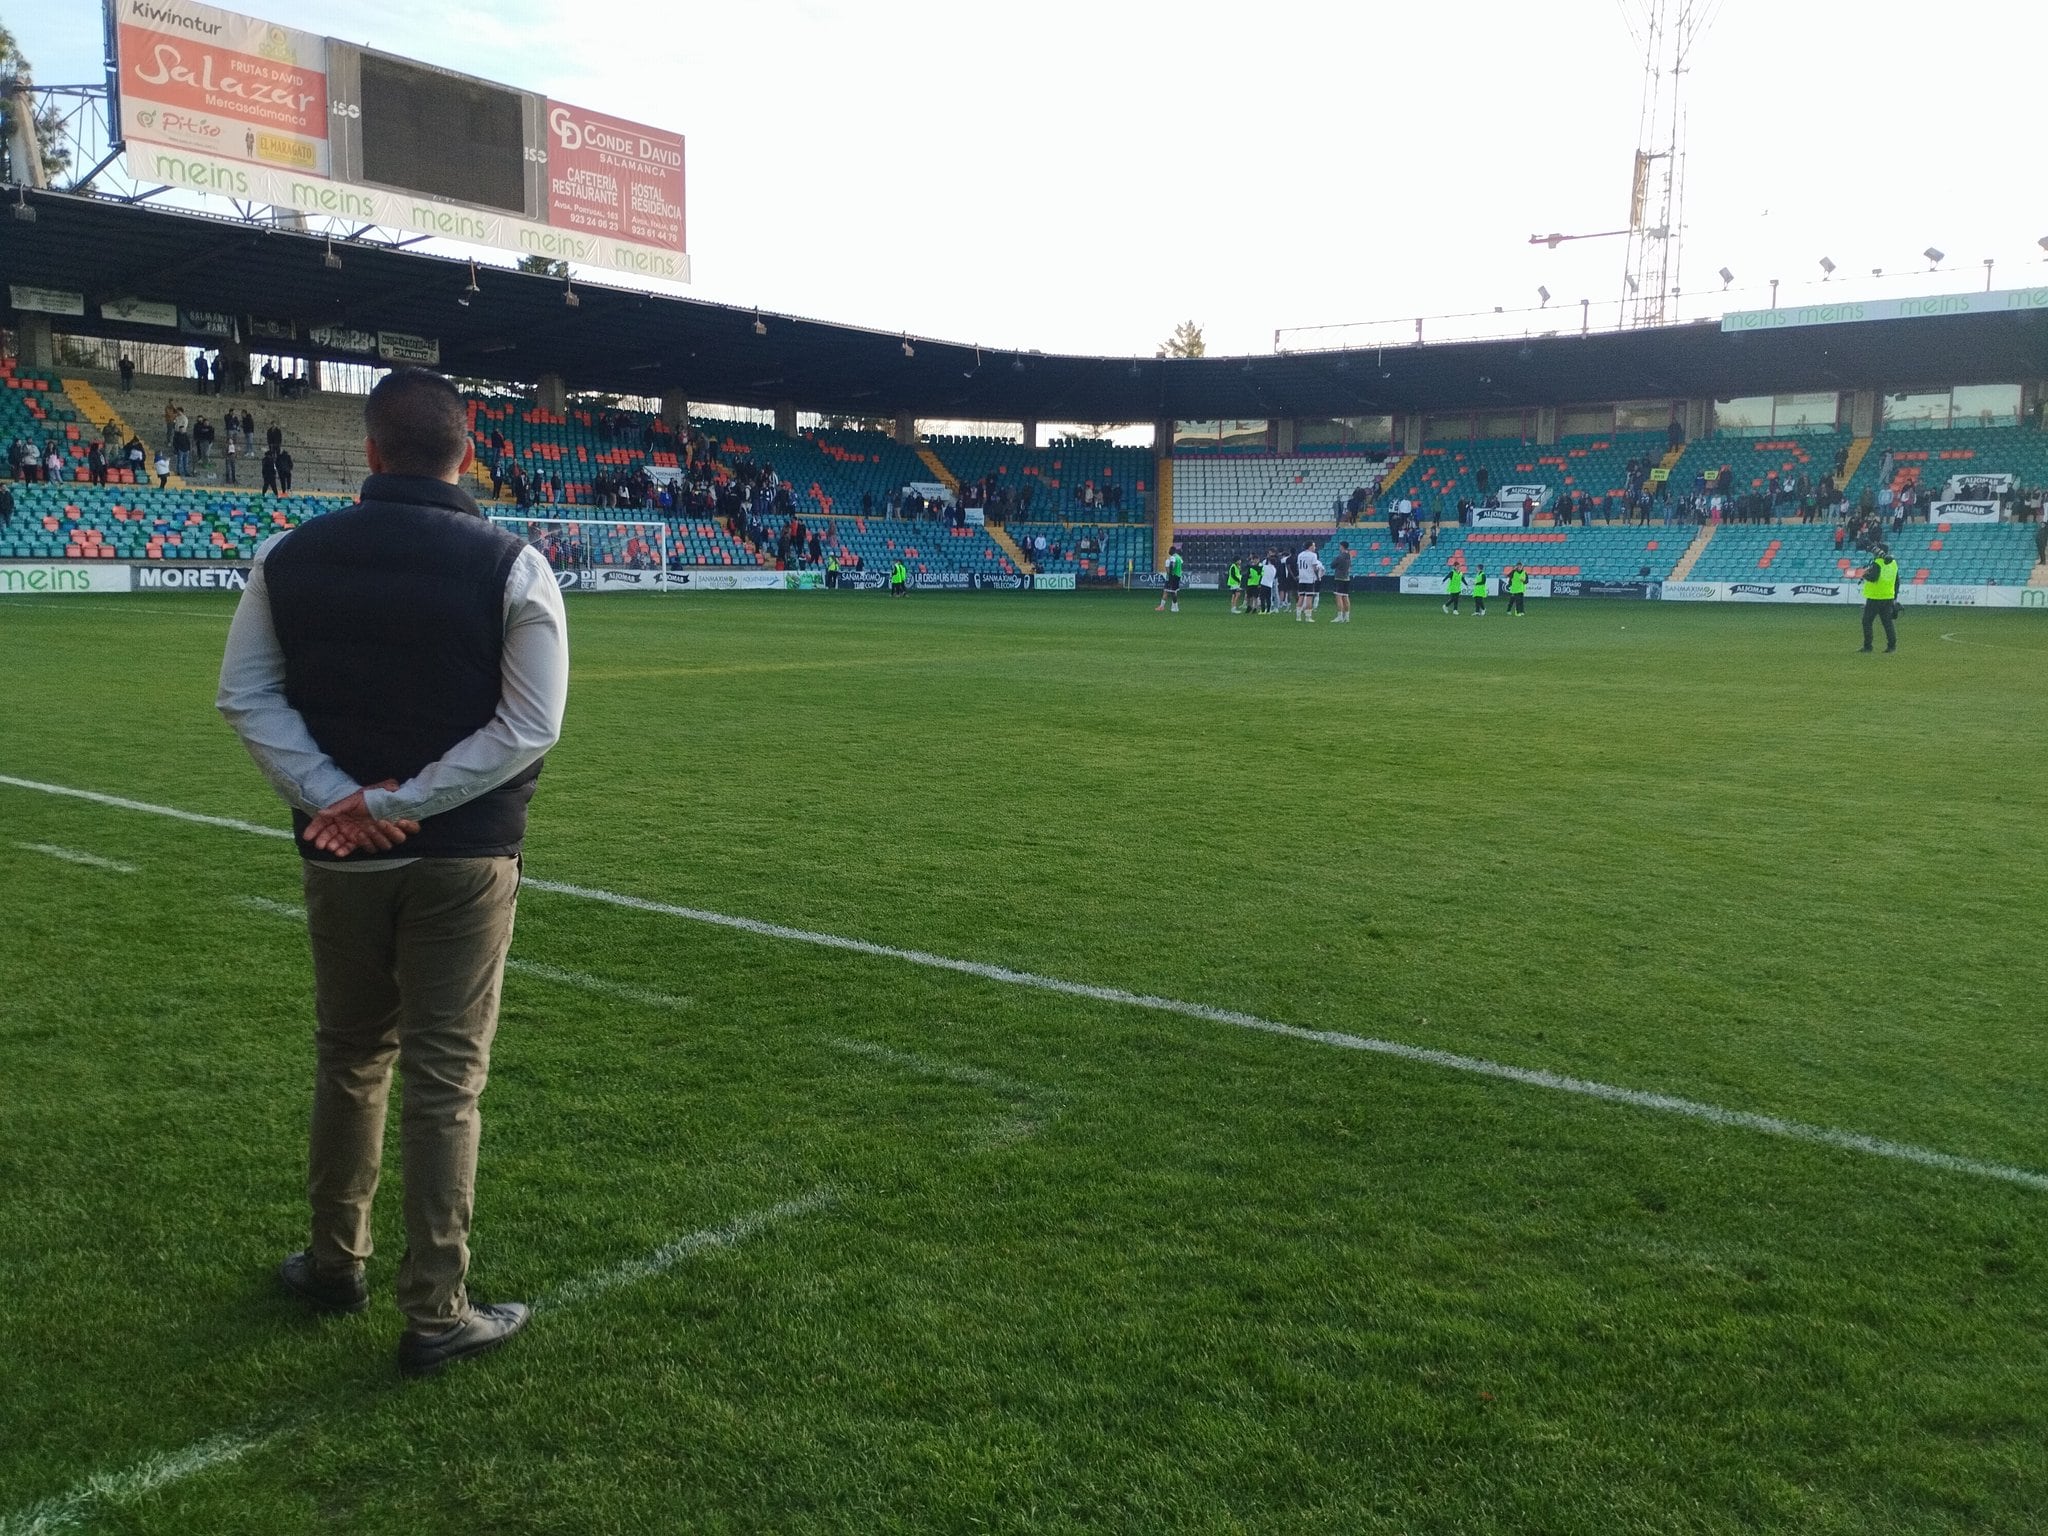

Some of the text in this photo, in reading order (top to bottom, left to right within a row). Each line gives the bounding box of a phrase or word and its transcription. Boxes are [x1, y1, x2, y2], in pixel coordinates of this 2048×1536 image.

[132, 1, 222, 35] Kiwinatur
[134, 44, 316, 112] Salazar
[231, 60, 303, 86] FRUTAS DAVID
[205, 93, 306, 127] Mercasalamanca
[260, 136, 269, 150] EL
[270, 138, 312, 159] MARAGATO
[156, 154, 248, 193] meins
[600, 152, 666, 178] SALAMANCA
[291, 182, 374, 217] meins
[552, 178, 618, 207] RESTAURANTE
[631, 182, 665, 202] HOSTAL
[631, 196, 682, 221] RESIDENCIA
[412, 206, 486, 239] meins
[570, 213, 585, 224] 923
[586, 216, 597, 226] 24
[608, 221, 619, 231] 23
[631, 225, 646, 236] 923
[519, 228, 585, 259] meins
[614, 247, 675, 276] meins
[1798, 303, 1864, 324] meins
[1900, 295, 1969, 315] meins
[1723, 309, 1786, 329] meins
[1299, 559, 1309, 570] 16
[0, 566, 91, 591] meins
[1035, 575, 1075, 589] meins
[1737, 585, 1768, 595] ALJOMAR
[1799, 586, 1832, 596] ALJOMAR
